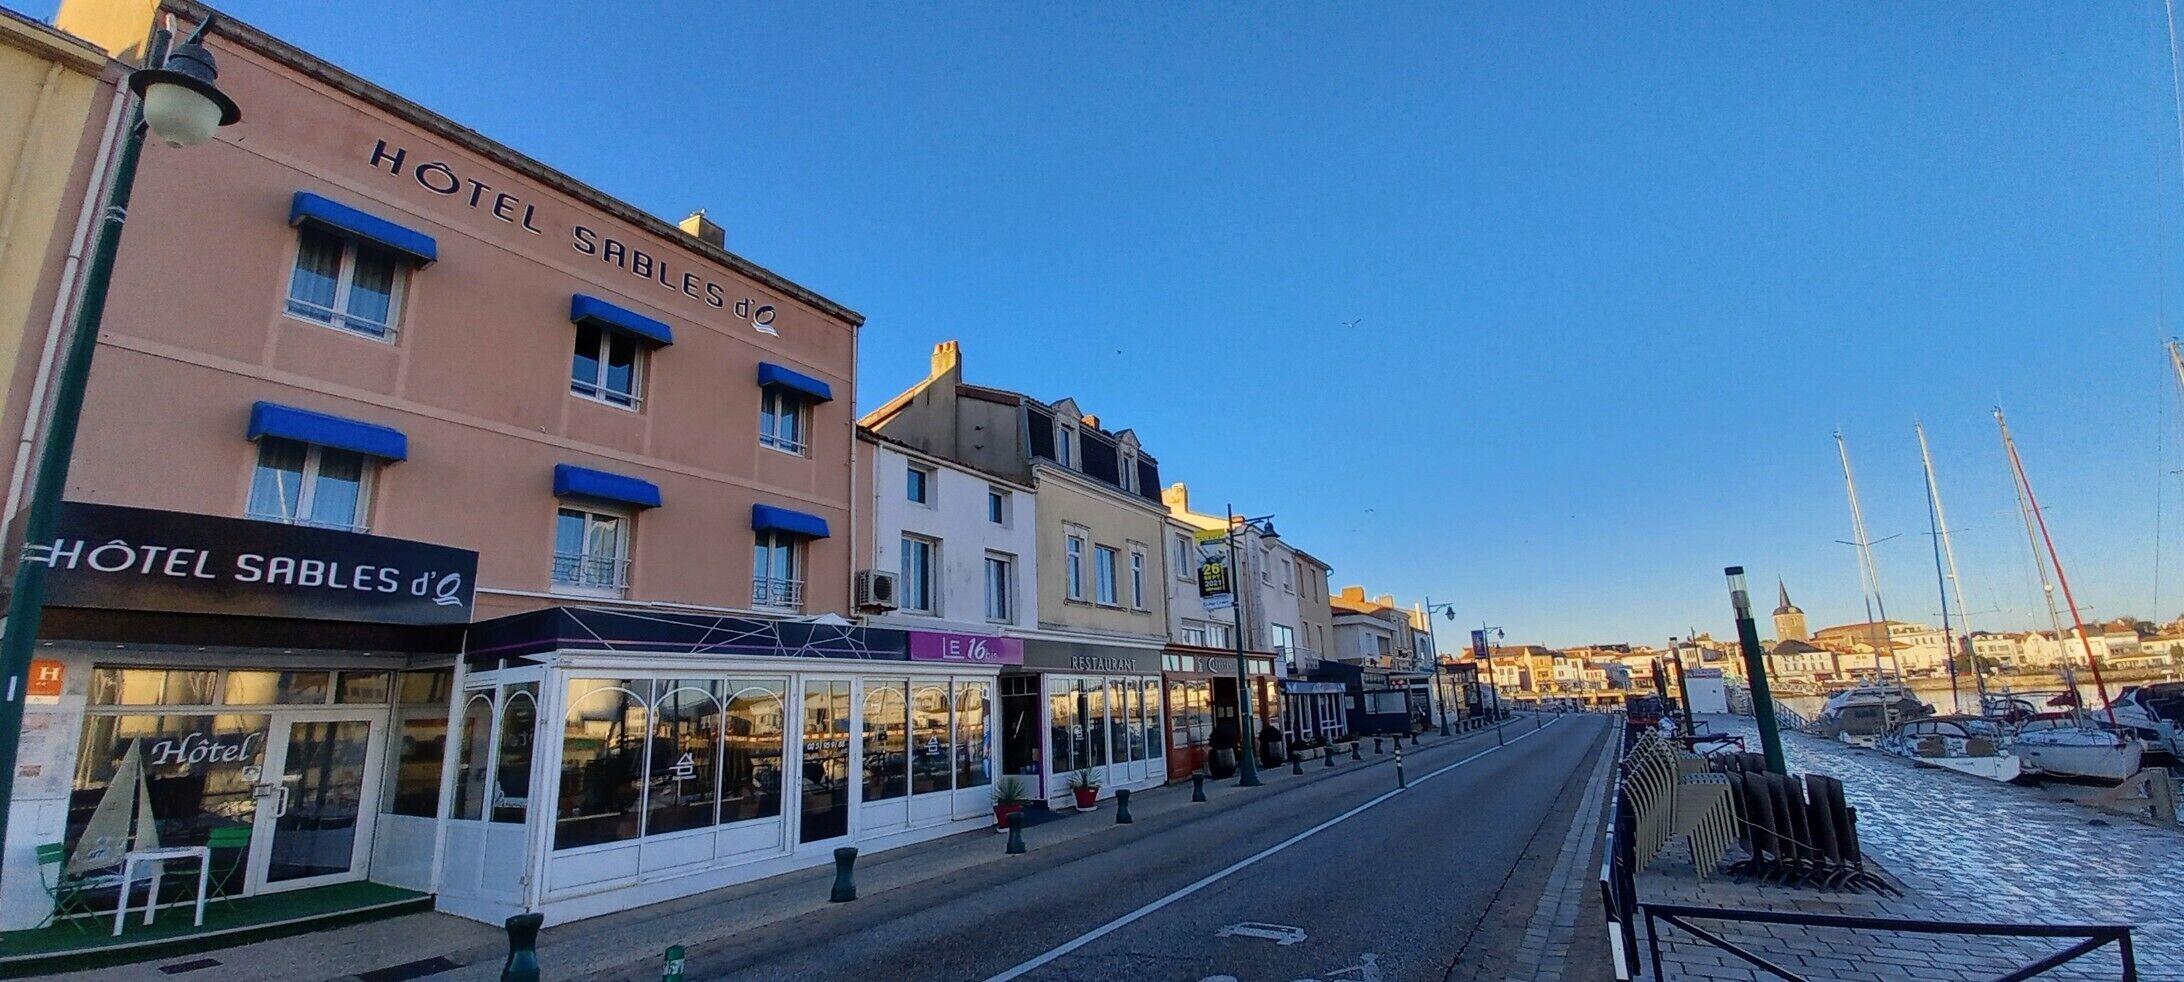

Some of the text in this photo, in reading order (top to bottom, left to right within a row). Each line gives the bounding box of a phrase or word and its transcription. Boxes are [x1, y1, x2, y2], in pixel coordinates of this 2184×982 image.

[368, 138, 543, 236] HÔTEL
[571, 225, 725, 310] SABLES
[48, 538, 216, 579] HÔTEL
[234, 553, 401, 595] SABLES
[1202, 563, 1221, 575] 26
[942, 636, 965, 660] LE
[39, 666, 61, 681] H
[1071, 656, 1136, 672] RESTAURANT
[151, 732, 261, 765] Hôtel
